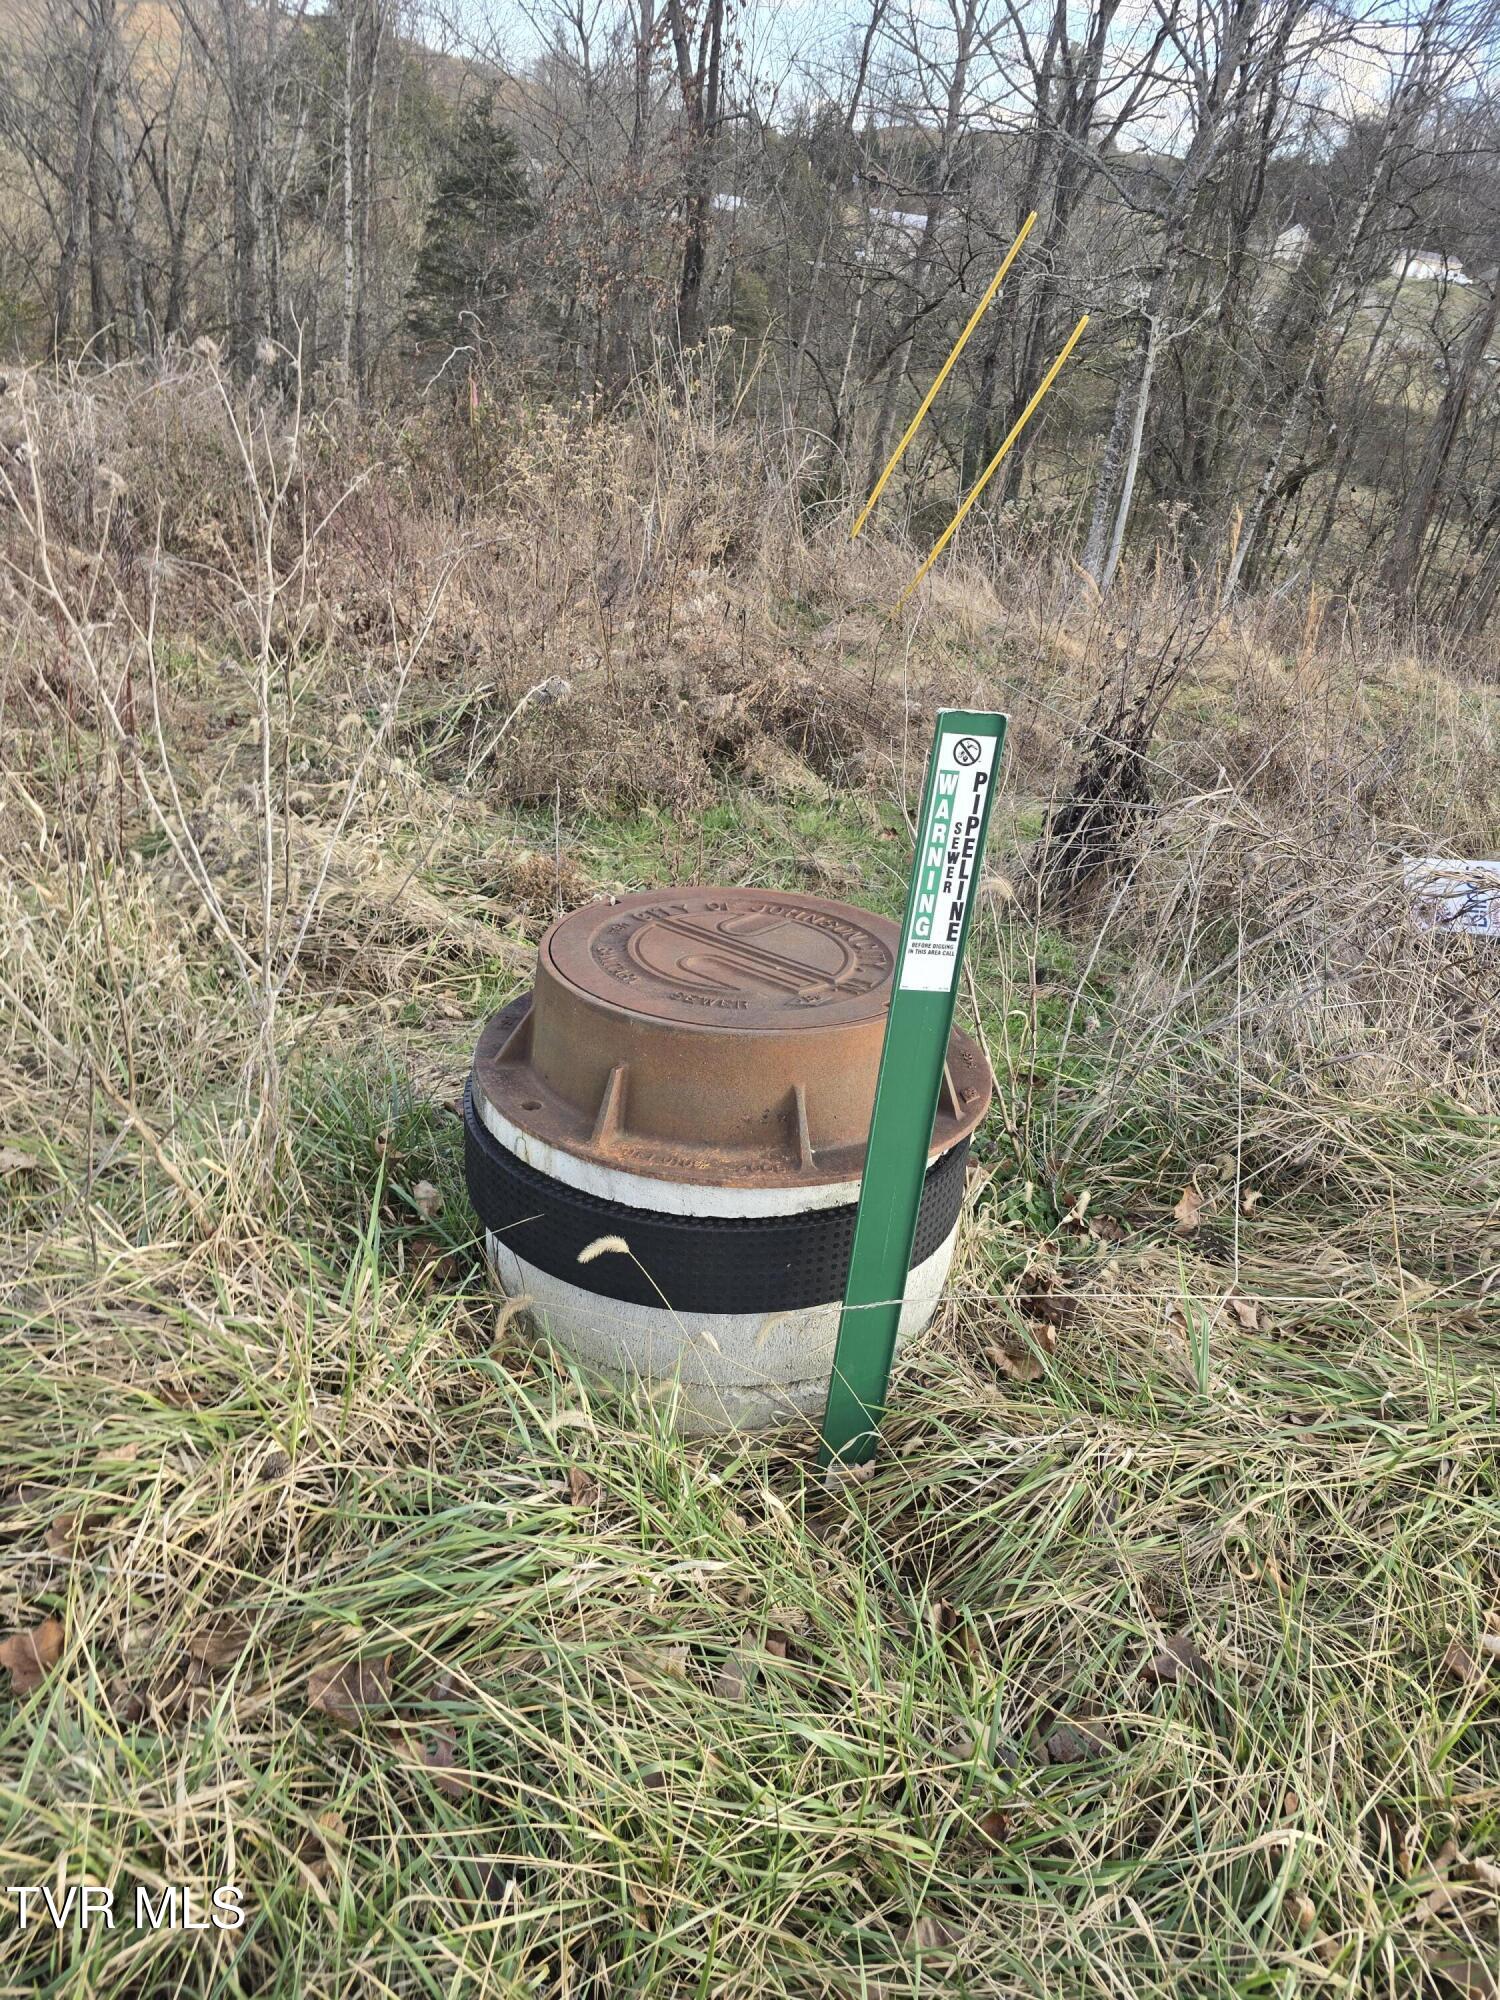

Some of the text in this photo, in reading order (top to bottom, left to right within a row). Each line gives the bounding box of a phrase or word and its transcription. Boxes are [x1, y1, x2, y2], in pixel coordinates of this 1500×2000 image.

[915, 773, 959, 937] WARNING
[943, 821, 963, 894] SEWER
[946, 771, 988, 942] PIPELINE
[751, 904, 869, 942] JOHNSON
